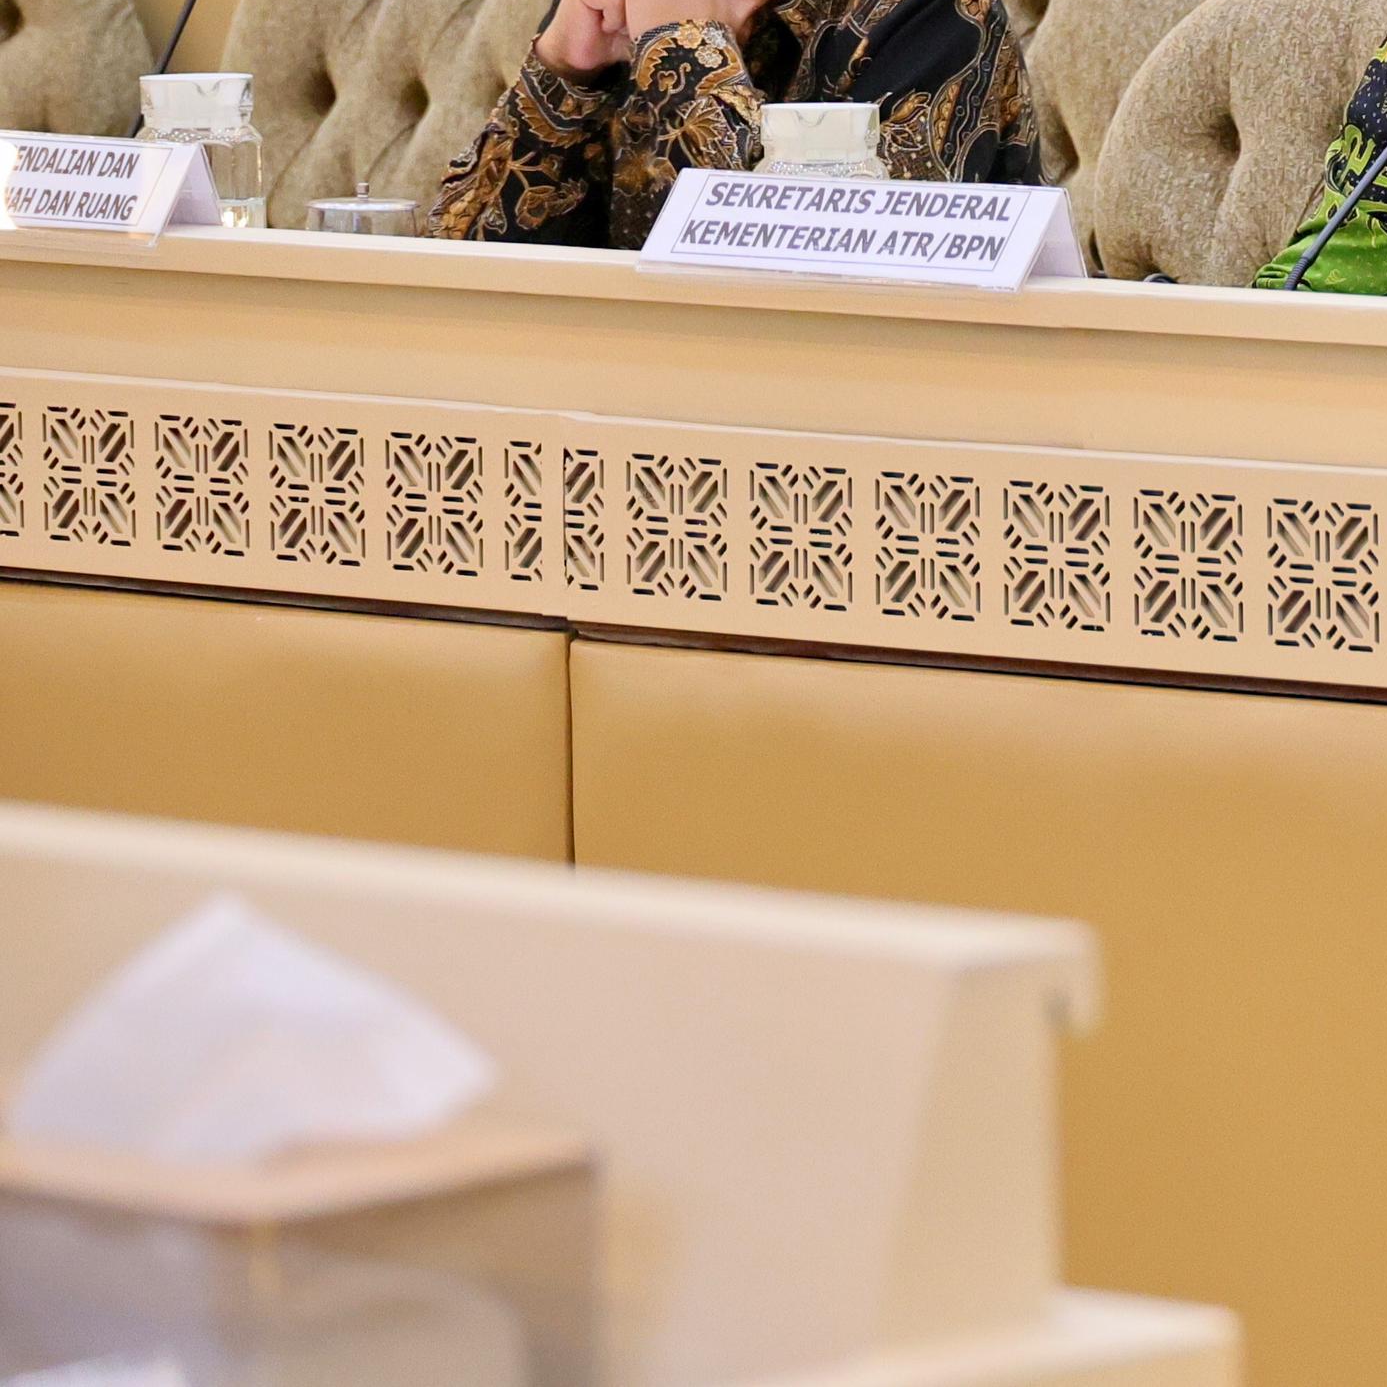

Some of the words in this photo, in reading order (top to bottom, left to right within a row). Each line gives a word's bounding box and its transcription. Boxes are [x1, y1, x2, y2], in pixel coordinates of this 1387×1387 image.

[97, 151, 140, 179] DAN
[34, 189, 76, 216] DAN
[72, 192, 138, 221] RUANG
[706, 182, 876, 214] SEKRETARIS
[875, 191, 1011, 222] JENDERAL
[681, 219, 876, 255] KEMENTERIAN
[877, 229, 1005, 263] ATR/BPN
